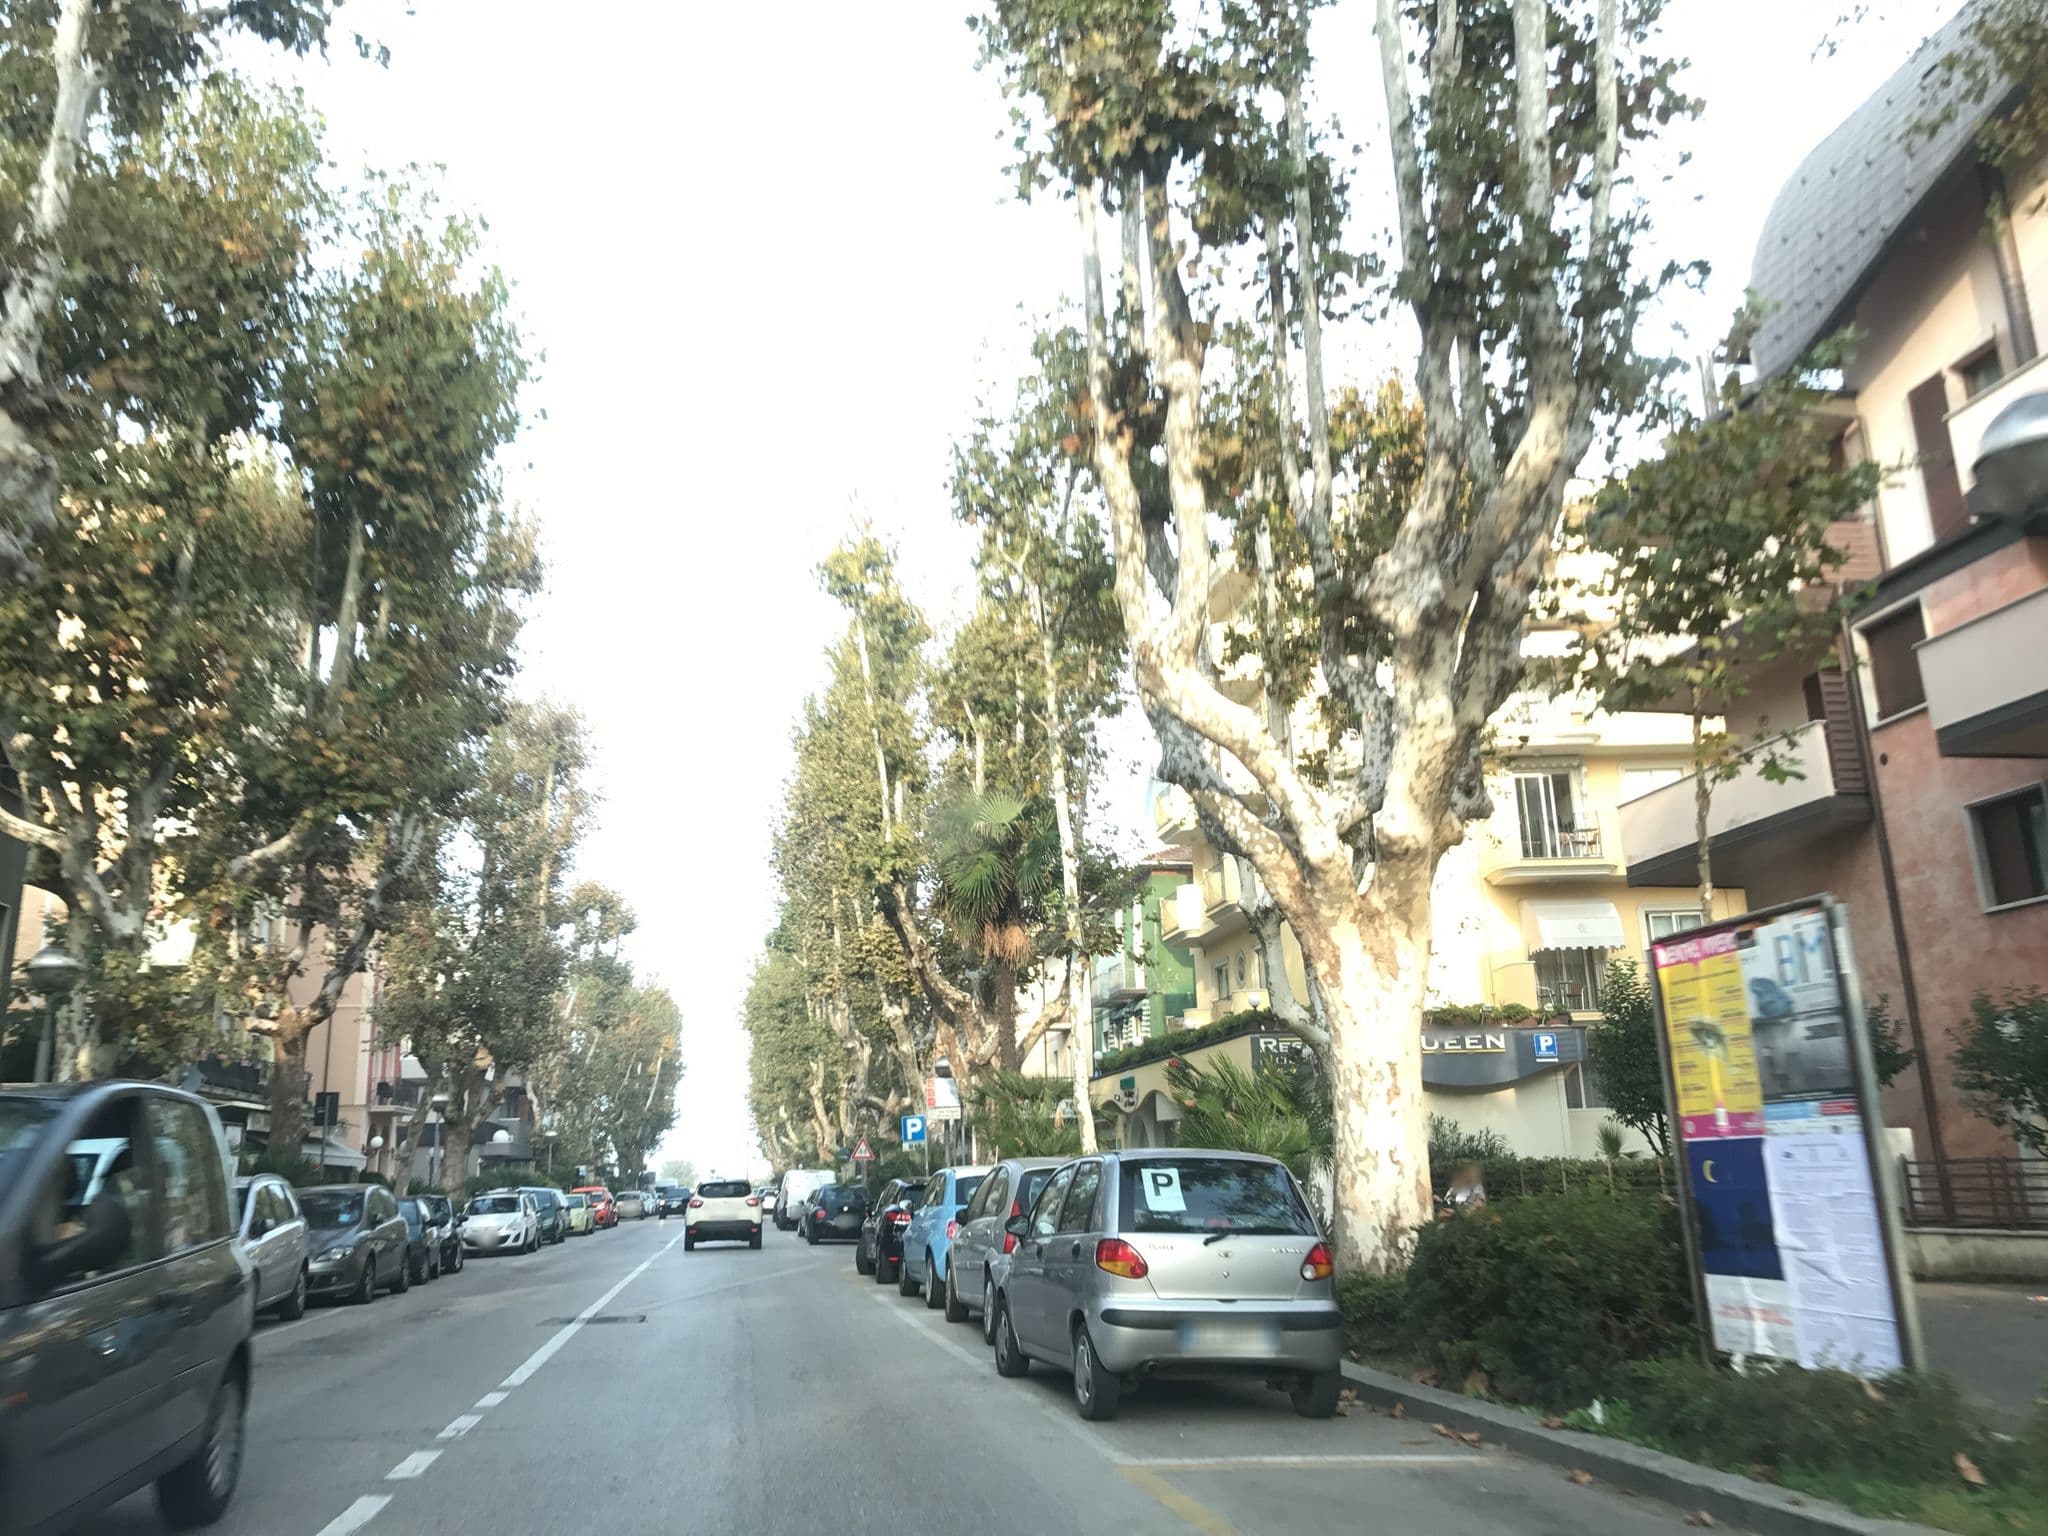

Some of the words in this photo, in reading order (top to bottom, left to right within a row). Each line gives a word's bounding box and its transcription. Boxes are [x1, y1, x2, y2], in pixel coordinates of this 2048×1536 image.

[1259, 1038, 1302, 1053] RES
[1421, 1033, 1505, 1050] UEEN
[1539, 1036, 1553, 1052] P
[906, 1118, 922, 1140] P
[1151, 1173, 1173, 1197] P
